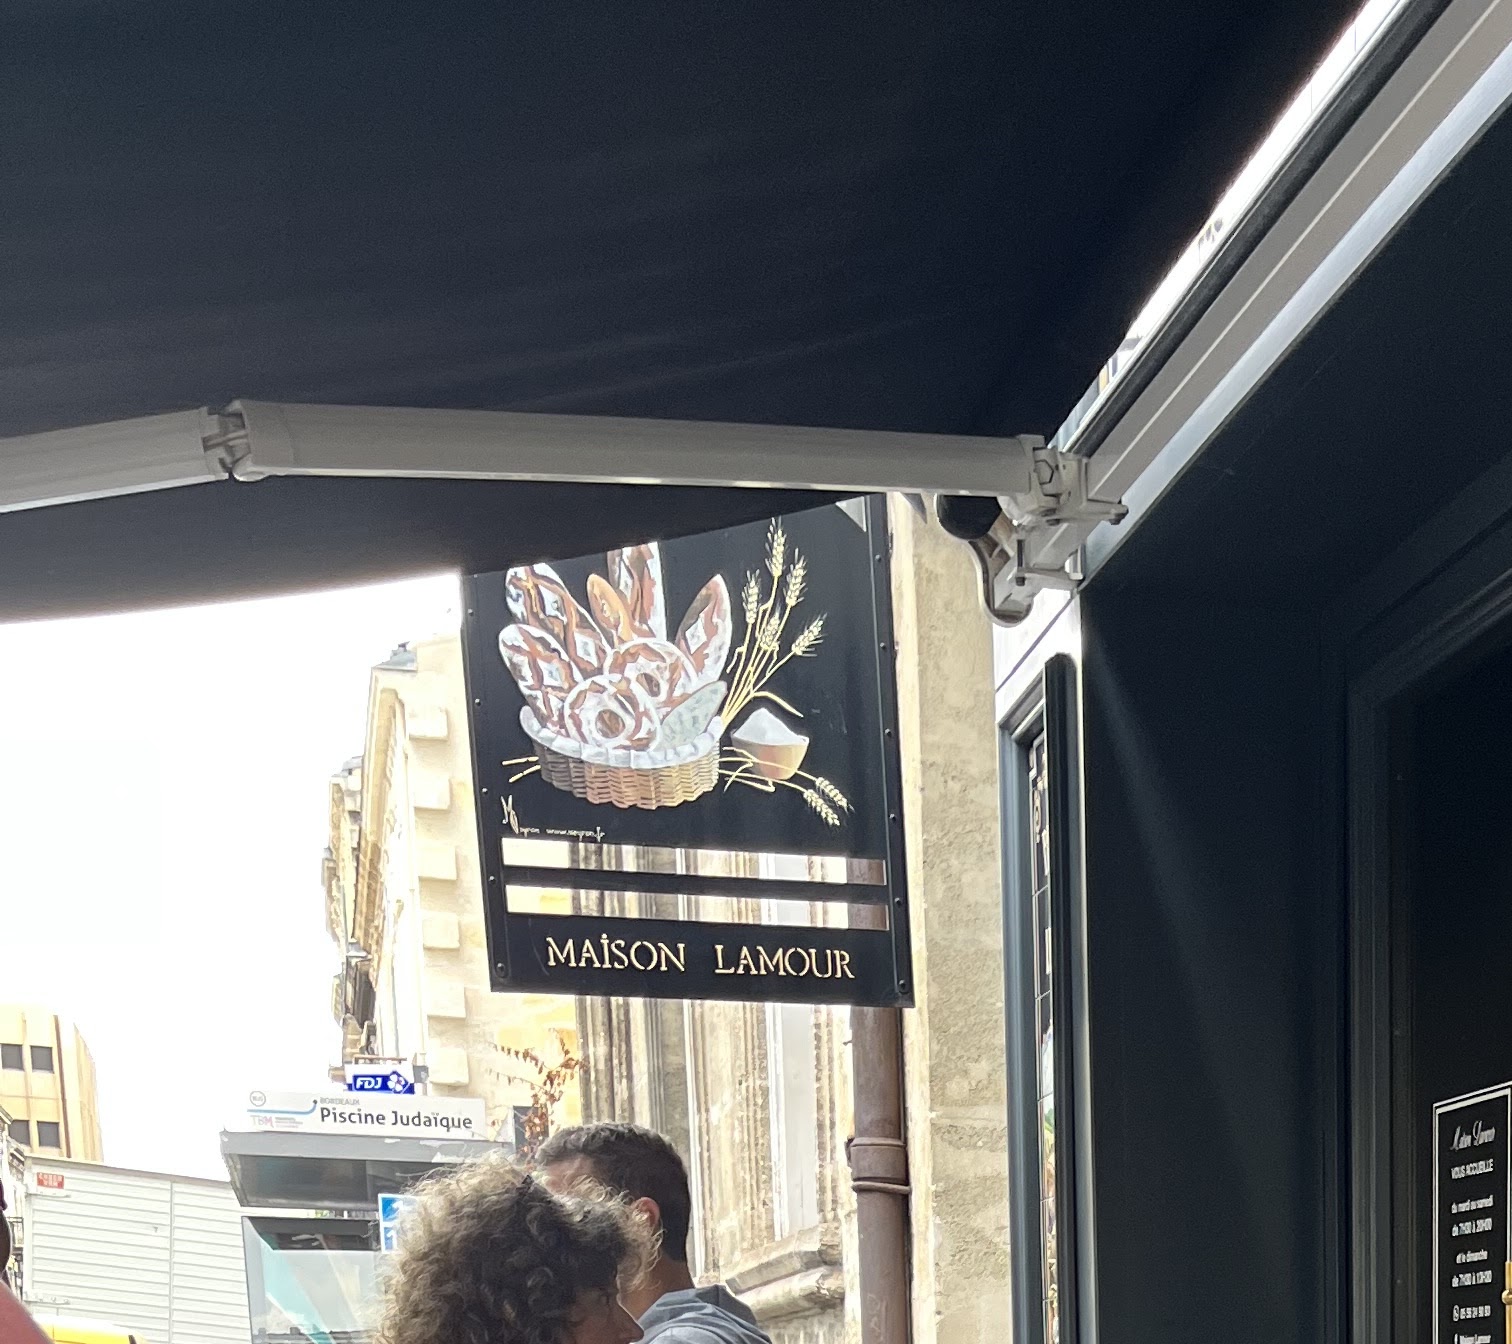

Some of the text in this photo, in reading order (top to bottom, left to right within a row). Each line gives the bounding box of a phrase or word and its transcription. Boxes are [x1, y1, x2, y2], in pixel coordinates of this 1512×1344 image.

[714, 944, 855, 979] LAMOUR
[355, 1077, 382, 1089] FDJ
[320, 1107, 386, 1125] Piscine
[391, 1110, 473, 1132] Judaïque
